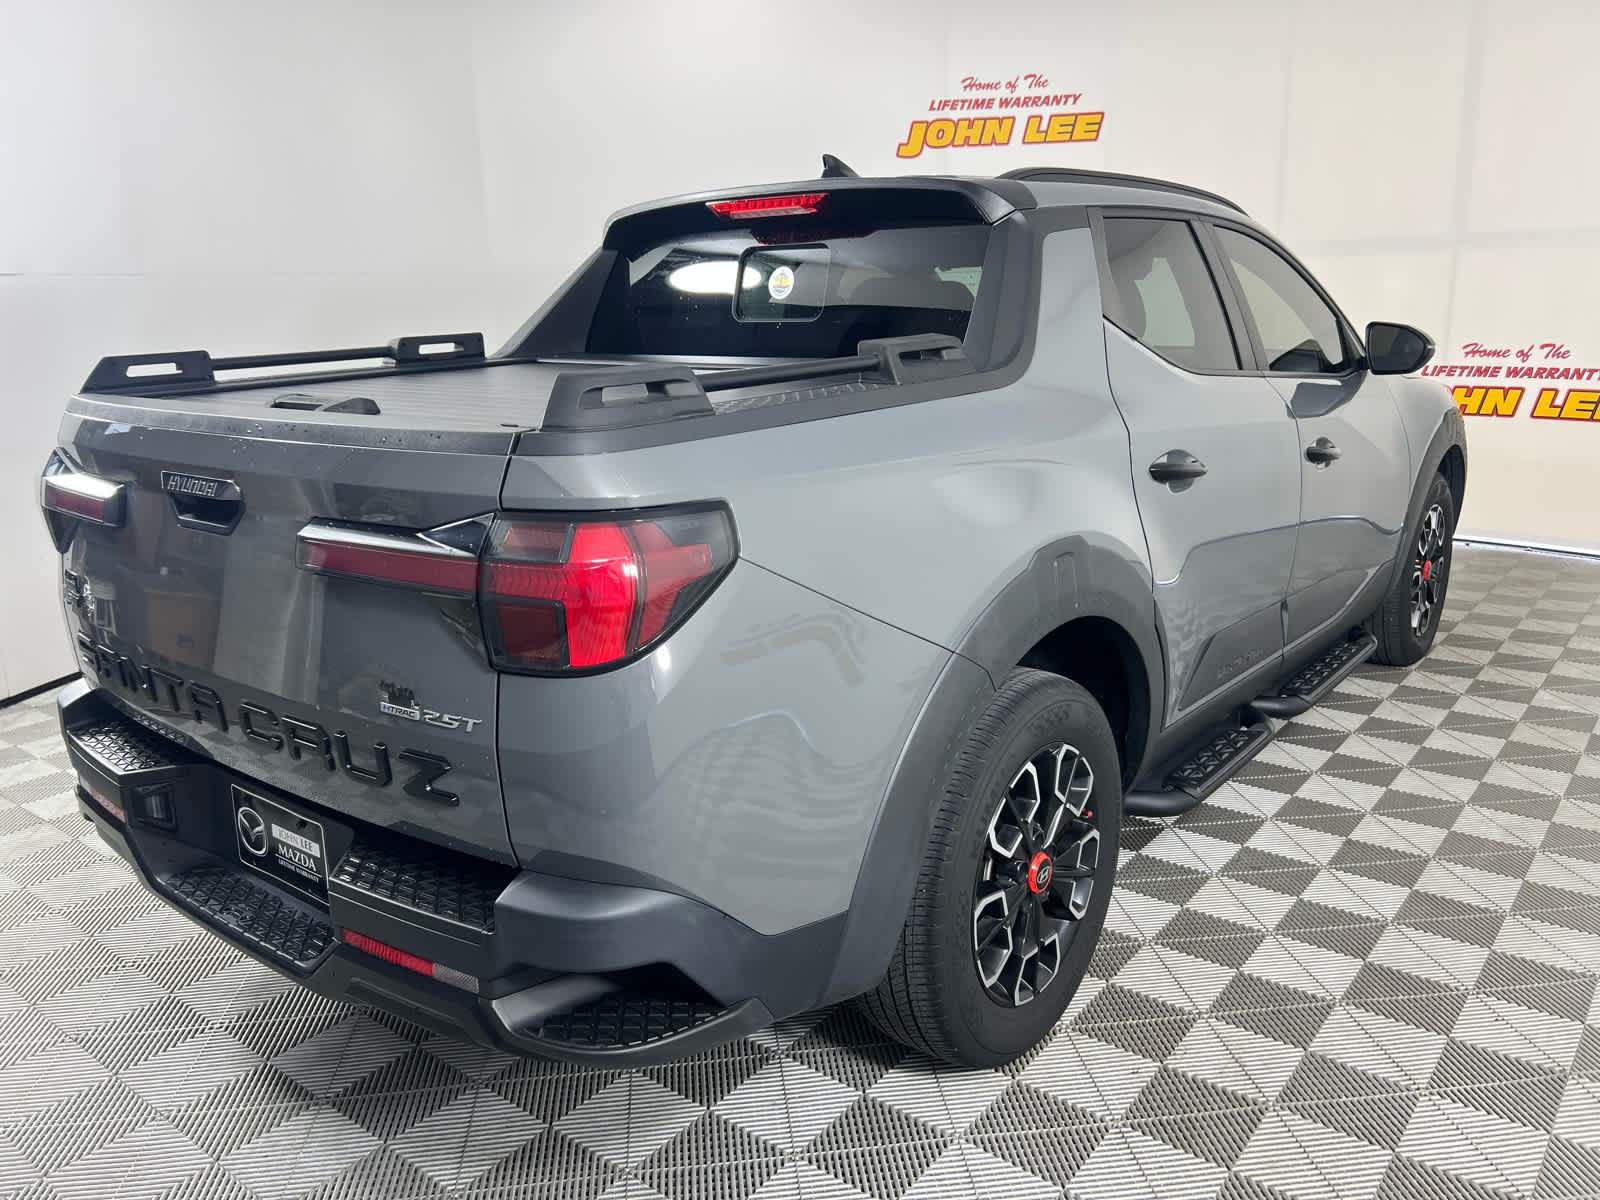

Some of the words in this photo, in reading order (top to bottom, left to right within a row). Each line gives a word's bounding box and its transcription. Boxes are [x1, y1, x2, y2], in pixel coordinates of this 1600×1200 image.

[960, 76, 1001, 92] Home
[1005, 75, 1019, 94] of
[1023, 73, 1049, 89] The
[928, 97, 995, 112] LIFETIME
[998, 93, 1083, 109] WARRANTY
[896, 116, 1016, 158] JOHN
[1022, 111, 1105, 144] LEE
[1462, 342, 1511, 359] Home
[1515, 344, 1535, 363] of
[1539, 343, 1571, 360] The
[1421, 365, 1502, 377] LIFETIME
[1505, 366, 1600, 381] WARRANT
[1447, 385, 1525, 418] HN
[1530, 387, 1600, 422] LE
[167, 475, 218, 497] HYUNDAI
[78, 631, 229, 733] SANTA
[239, 700, 460, 807] CRUZ
[382, 704, 416, 718] HTRAC
[278, 829, 299, 847] JOHN
[301, 838, 314, 853] LEE
[278, 843, 317, 871] MAZDA
